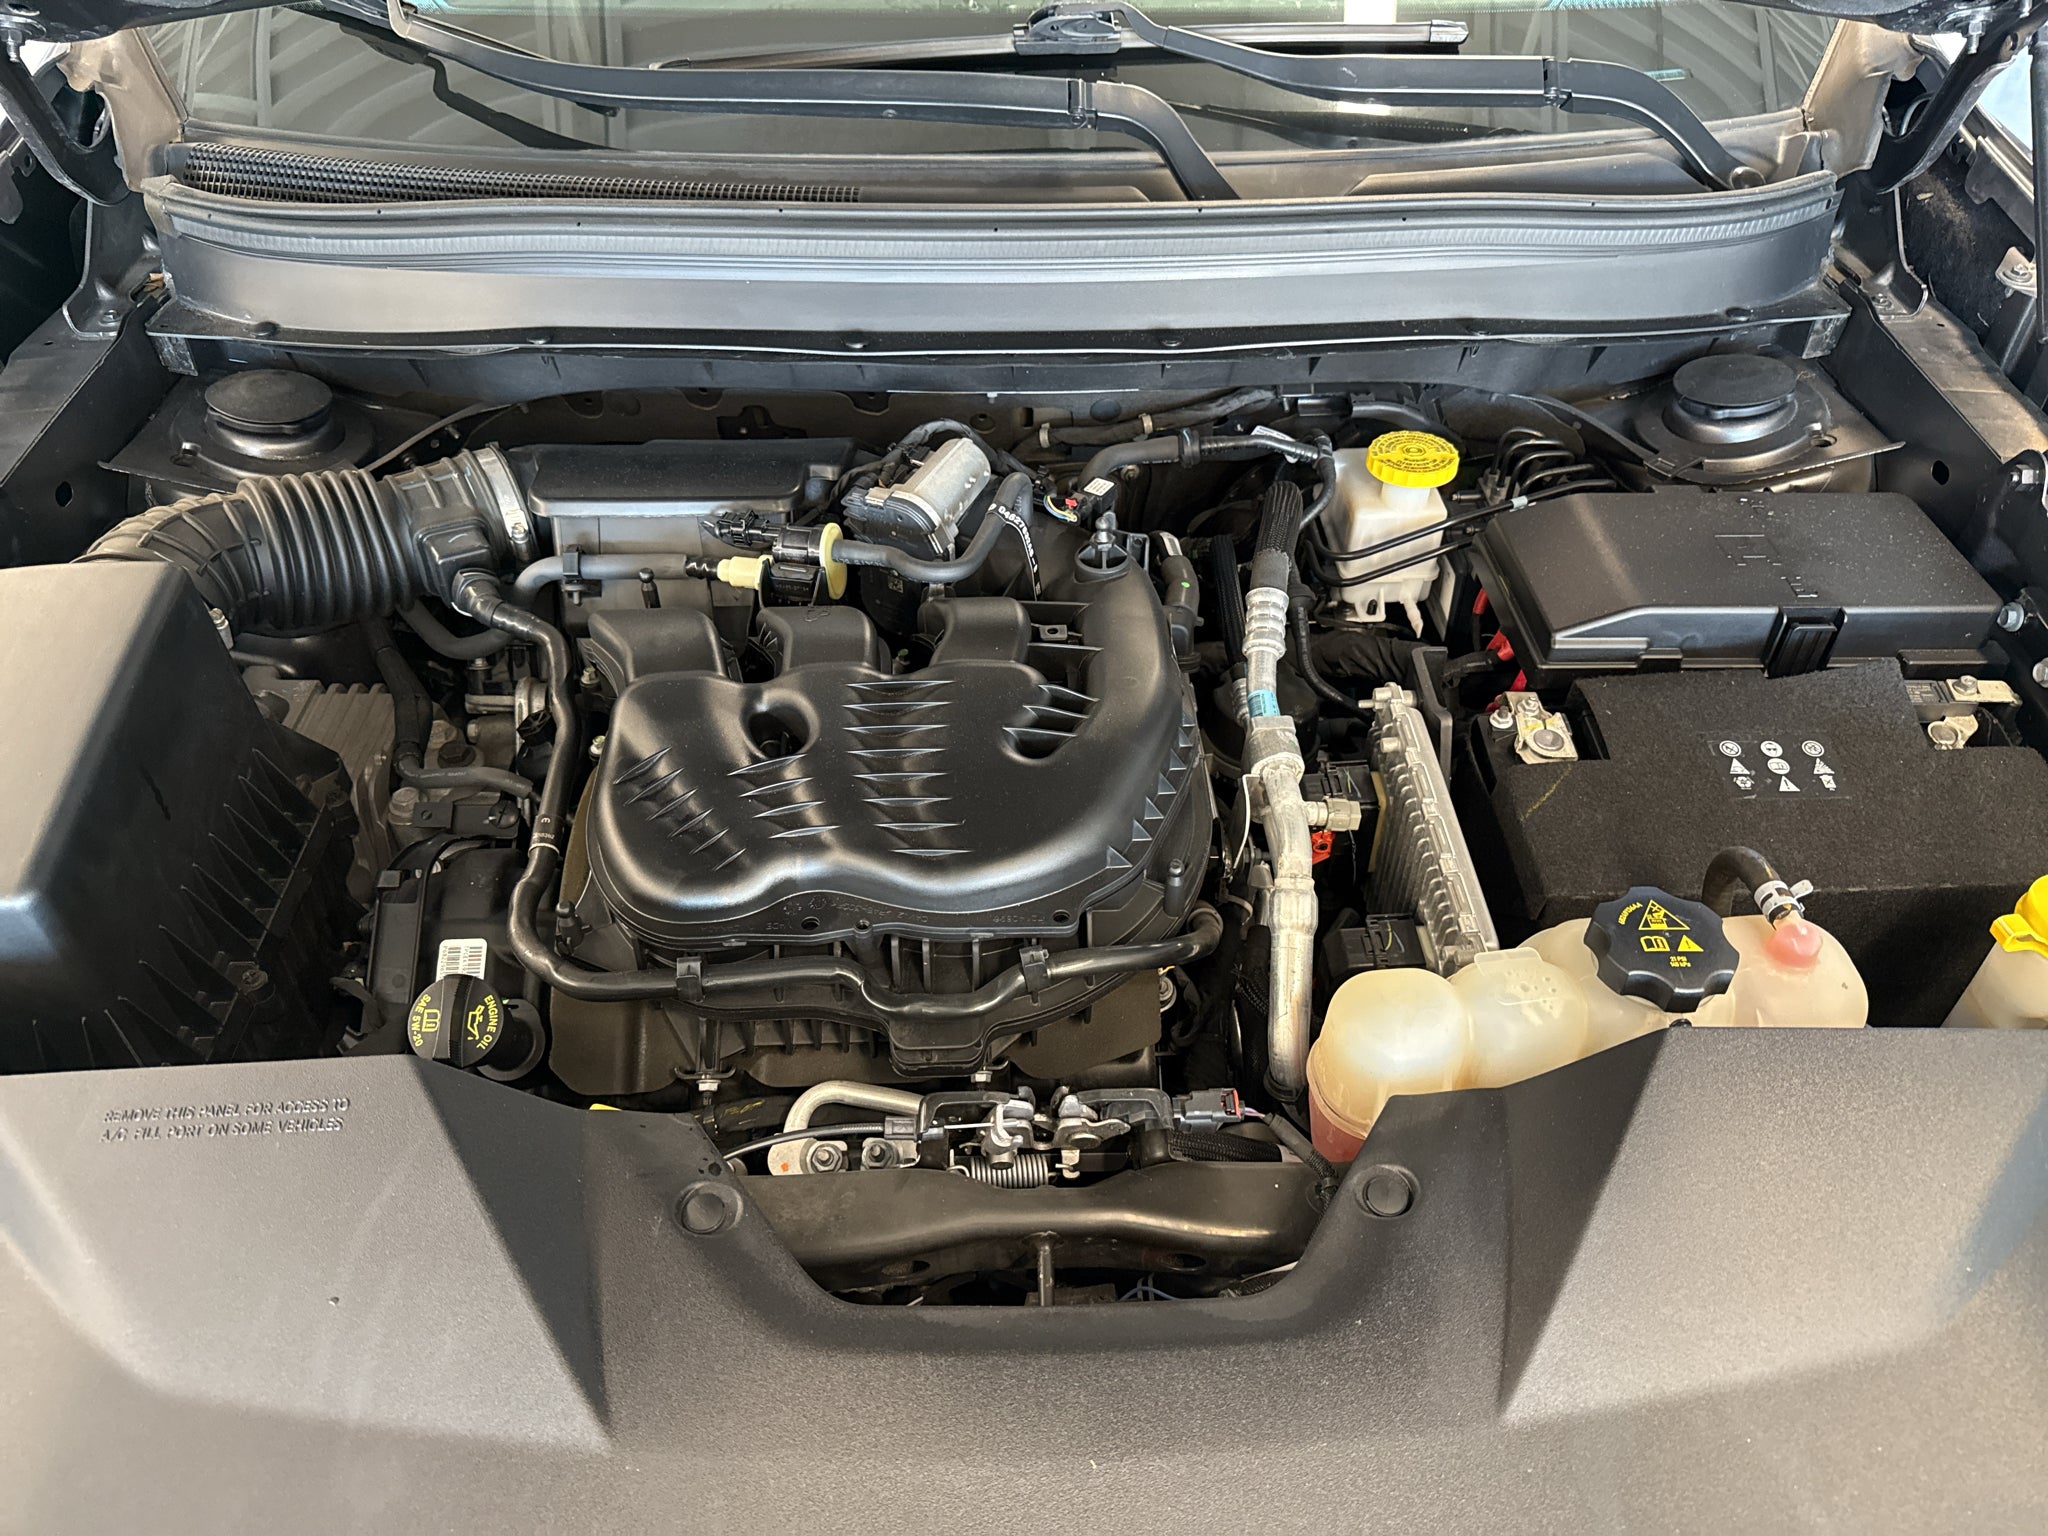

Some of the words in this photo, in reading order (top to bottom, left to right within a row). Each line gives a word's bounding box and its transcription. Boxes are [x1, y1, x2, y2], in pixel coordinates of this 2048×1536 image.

[415, 994, 431, 1013] SAE
[484, 995, 498, 1033] ENGINE
[412, 1015, 424, 1047] 5W-20
[476, 1034, 492, 1050] OIL
[103, 1107, 161, 1122] REMOVE
[165, 1106, 196, 1120] THIS
[198, 1103, 240, 1119] PANEL
[245, 1102, 273, 1116] FOR
[274, 1099, 329, 1114] ACCESS
[332, 1097, 350, 1112] TO
[100, 1127, 129, 1142] A/C
[133, 1126, 161, 1140] FILL
[166, 1123, 205, 1139] PORT
[208, 1122, 231, 1137] ON
[231, 1120, 273, 1136] SOME
[279, 1117, 344, 1134] VEHICLES
